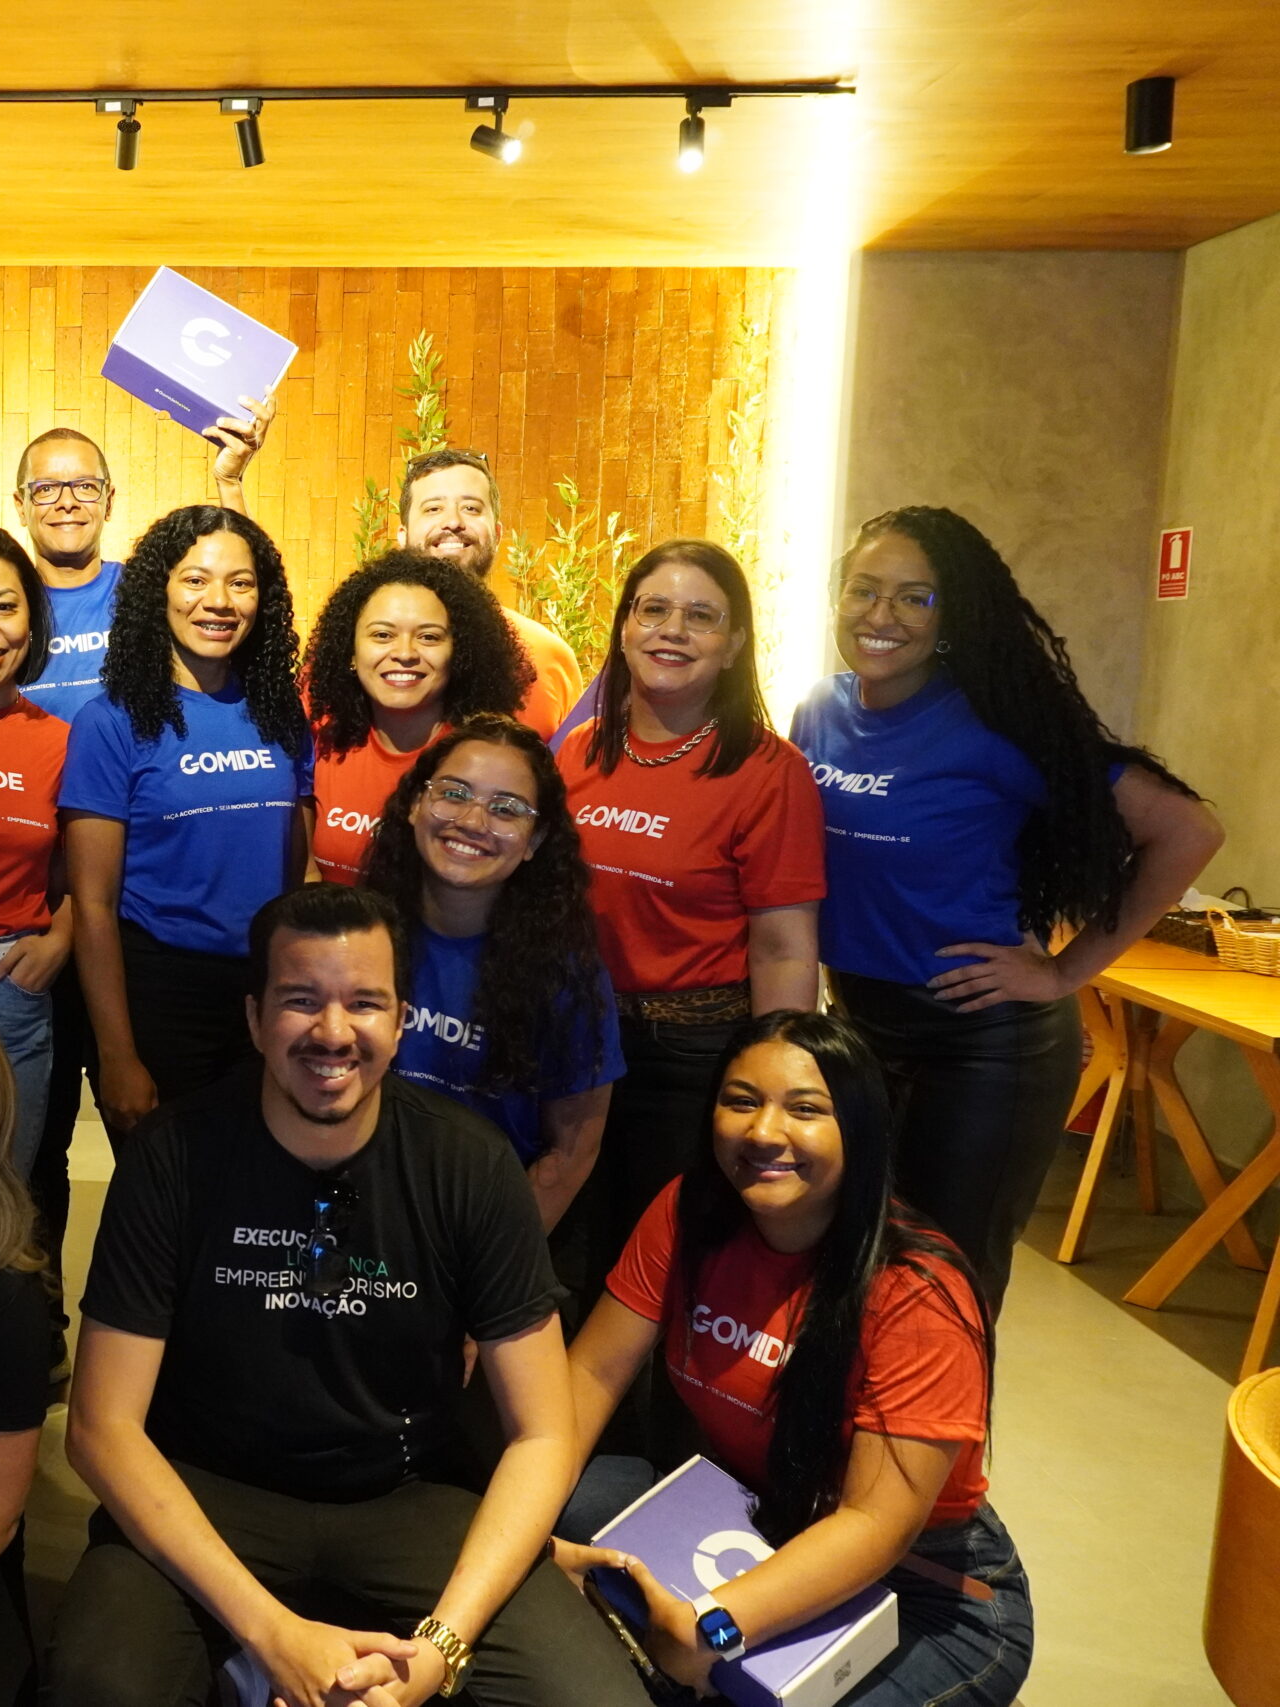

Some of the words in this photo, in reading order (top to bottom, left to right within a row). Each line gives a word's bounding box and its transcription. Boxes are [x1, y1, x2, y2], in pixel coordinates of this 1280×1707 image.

[179, 749, 276, 775] GOMIDE
[808, 761, 895, 797] OMIDE
[575, 804, 671, 839] GOMIDE
[853, 831, 911, 843] EMPREENDA-SE
[264, 1291, 367, 1320] INOVAÇÃO
